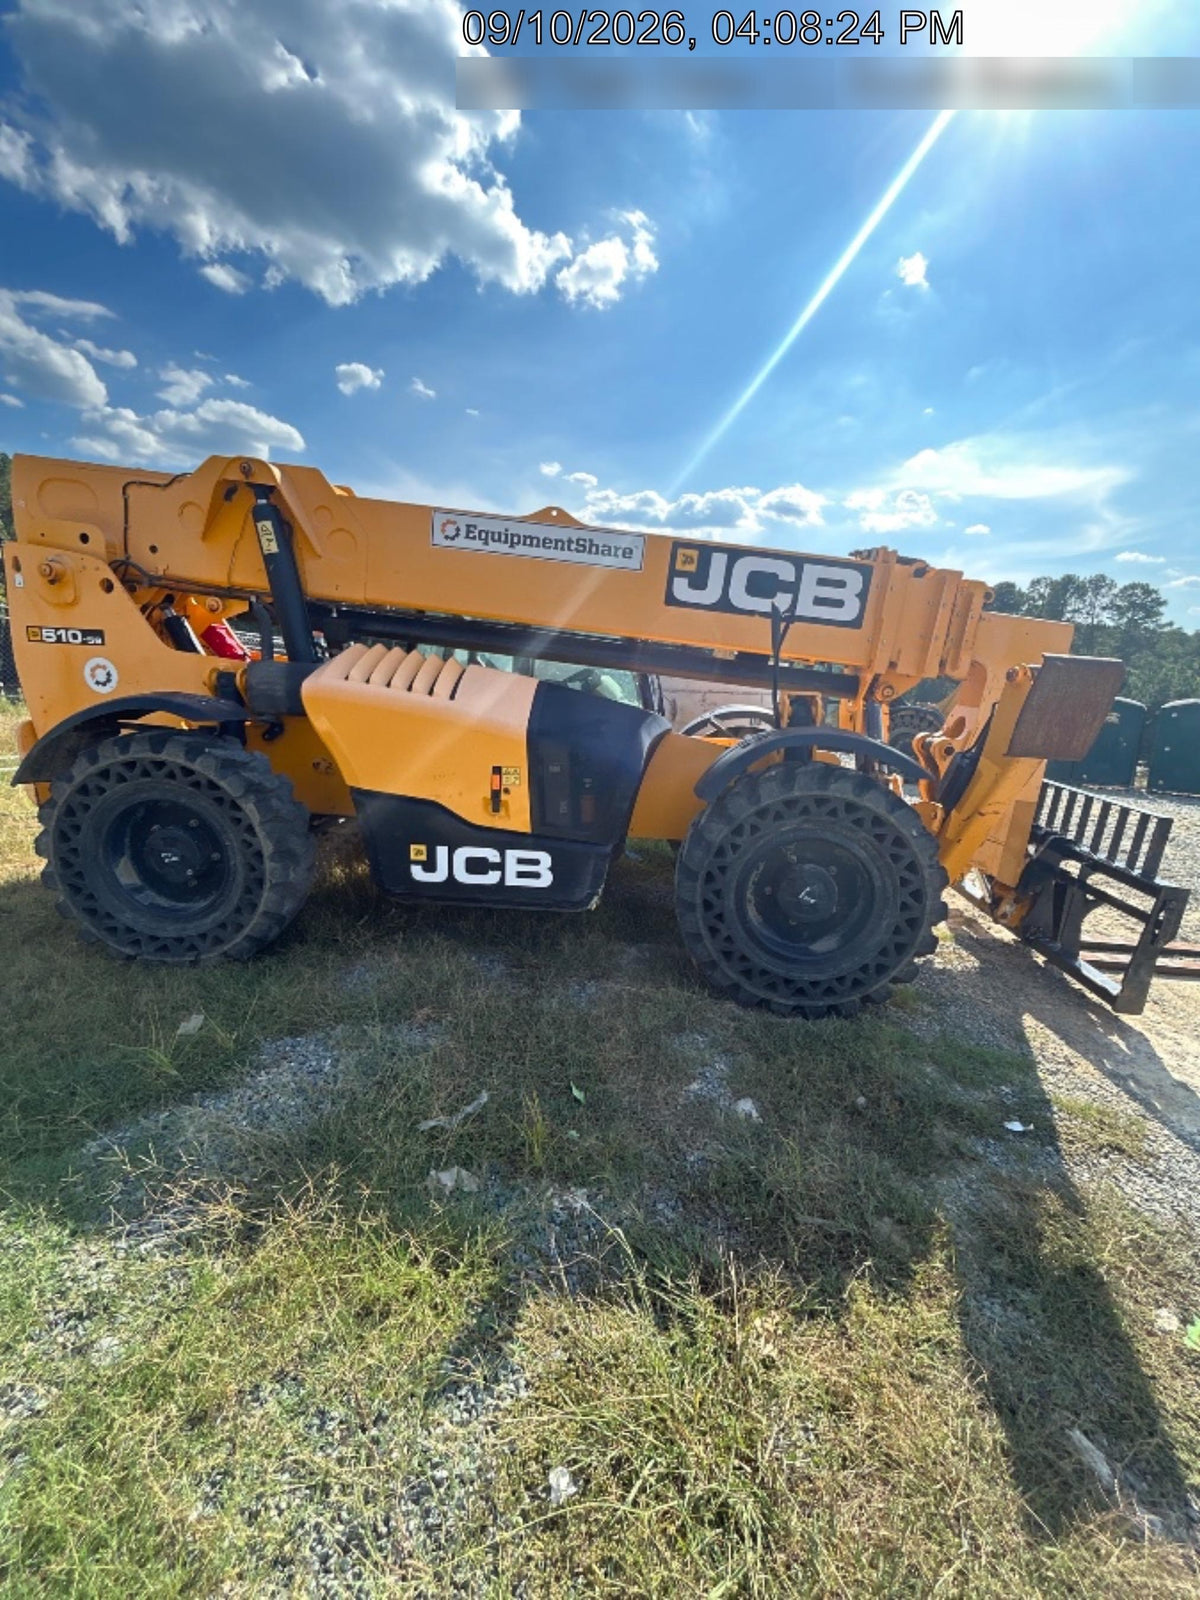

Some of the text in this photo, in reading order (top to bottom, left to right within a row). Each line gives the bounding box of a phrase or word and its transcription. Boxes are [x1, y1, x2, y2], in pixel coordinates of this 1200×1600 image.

[464, 523, 635, 560] EquipmentShare
[672, 552, 864, 622] JCB
[410, 845, 554, 888] JCB
